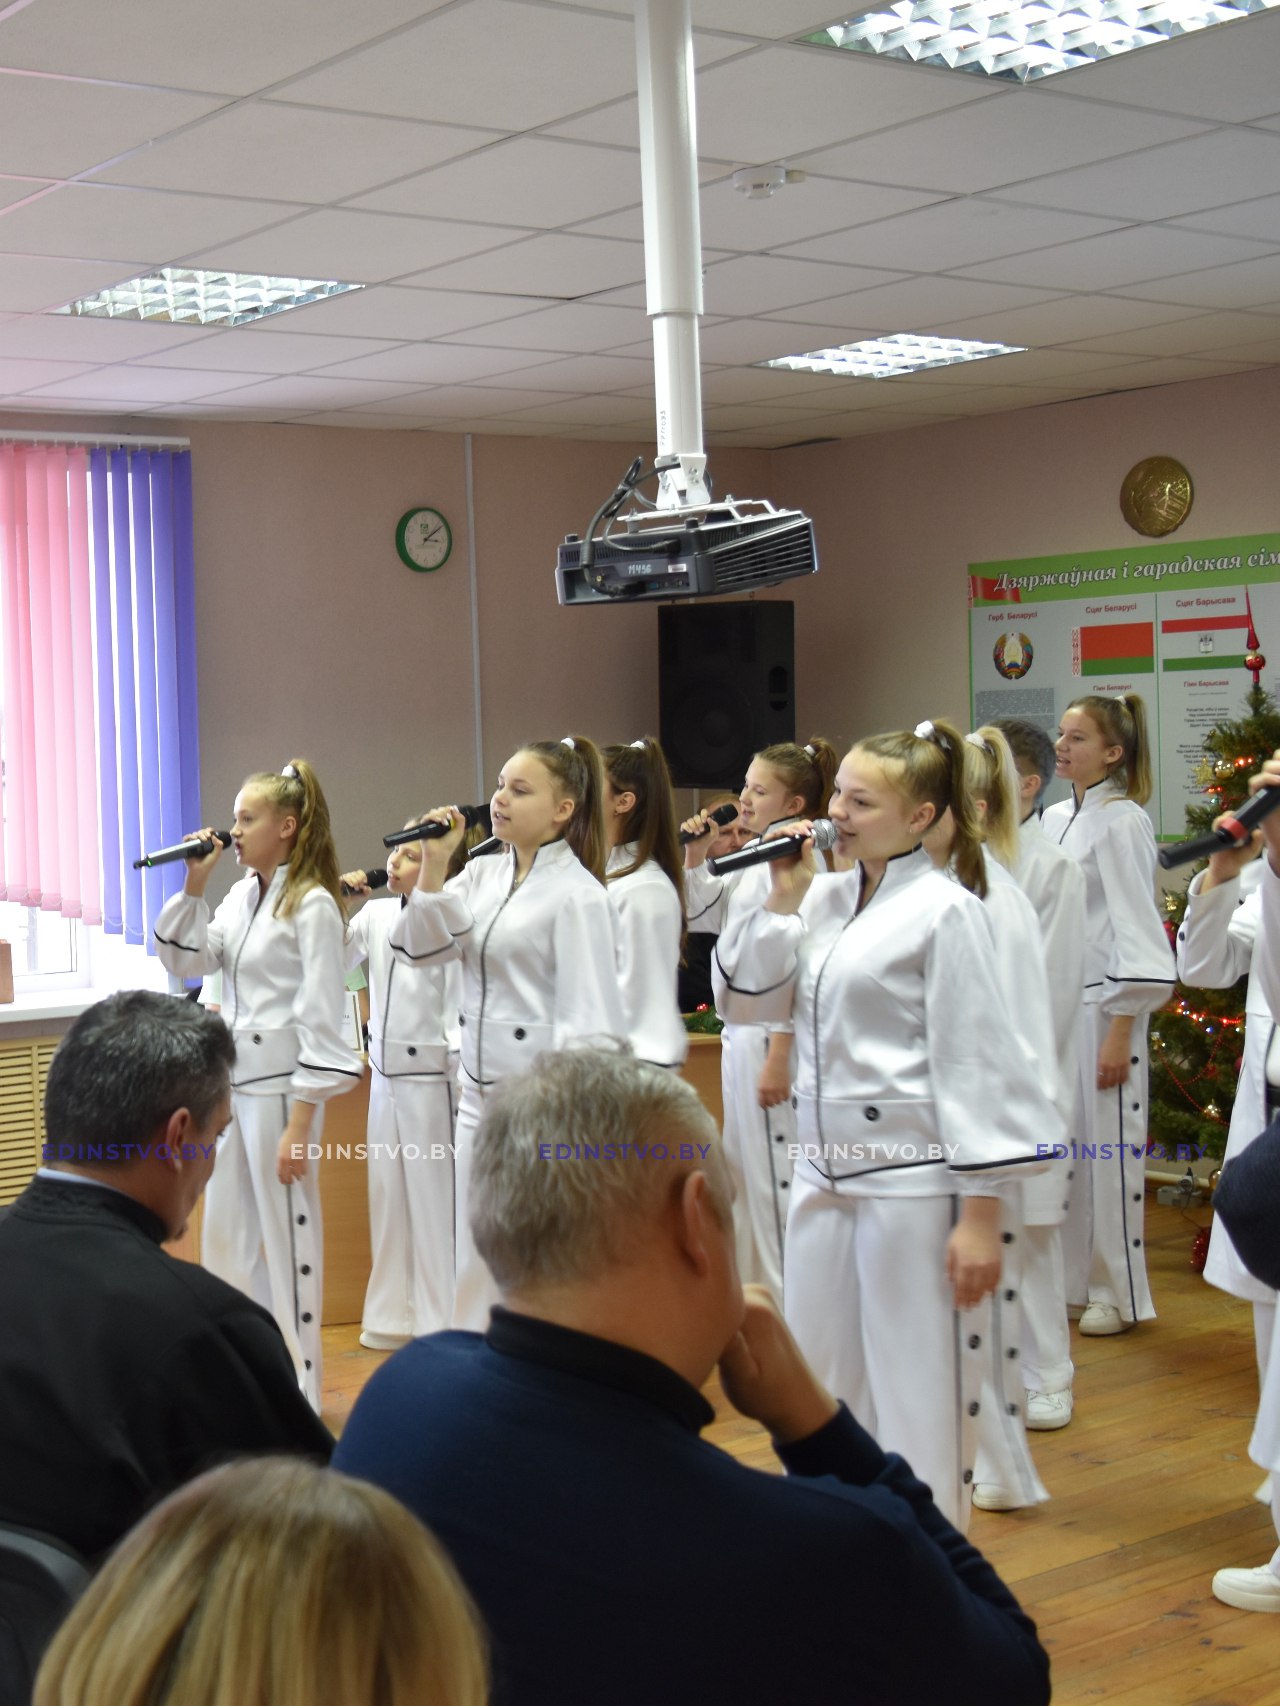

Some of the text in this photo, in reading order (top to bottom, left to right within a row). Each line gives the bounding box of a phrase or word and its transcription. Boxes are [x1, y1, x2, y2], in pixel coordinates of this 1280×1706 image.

[993, 565, 1117, 592] Дзяржаўная
[1122, 561, 1129, 578] і
[1133, 555, 1241, 580] гарадская
[1085, 602, 1137, 614] Сцяг Беларусі
[1176, 596, 1236, 608] Сцяг Барысава
[988, 611, 1038, 622] Герб Беларусі
